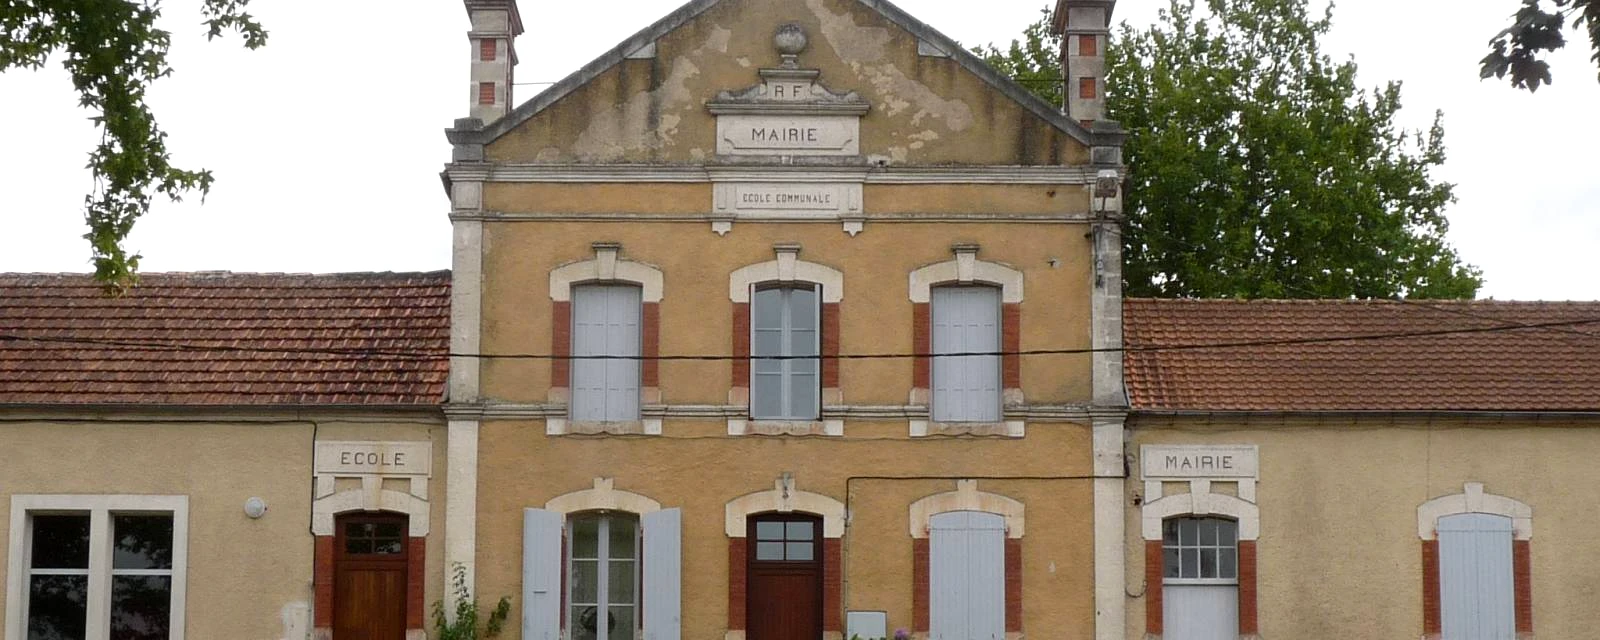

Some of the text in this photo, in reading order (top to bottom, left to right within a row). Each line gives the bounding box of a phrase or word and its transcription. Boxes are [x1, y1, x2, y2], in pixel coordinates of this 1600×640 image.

[774, 85, 803, 97] R F
[751, 127, 817, 142] MAIRIE
[742, 193, 831, 204] ECOLE COMMUNALE
[341, 451, 405, 466] ECOLE
[1165, 455, 1233, 470] MAIRIE
